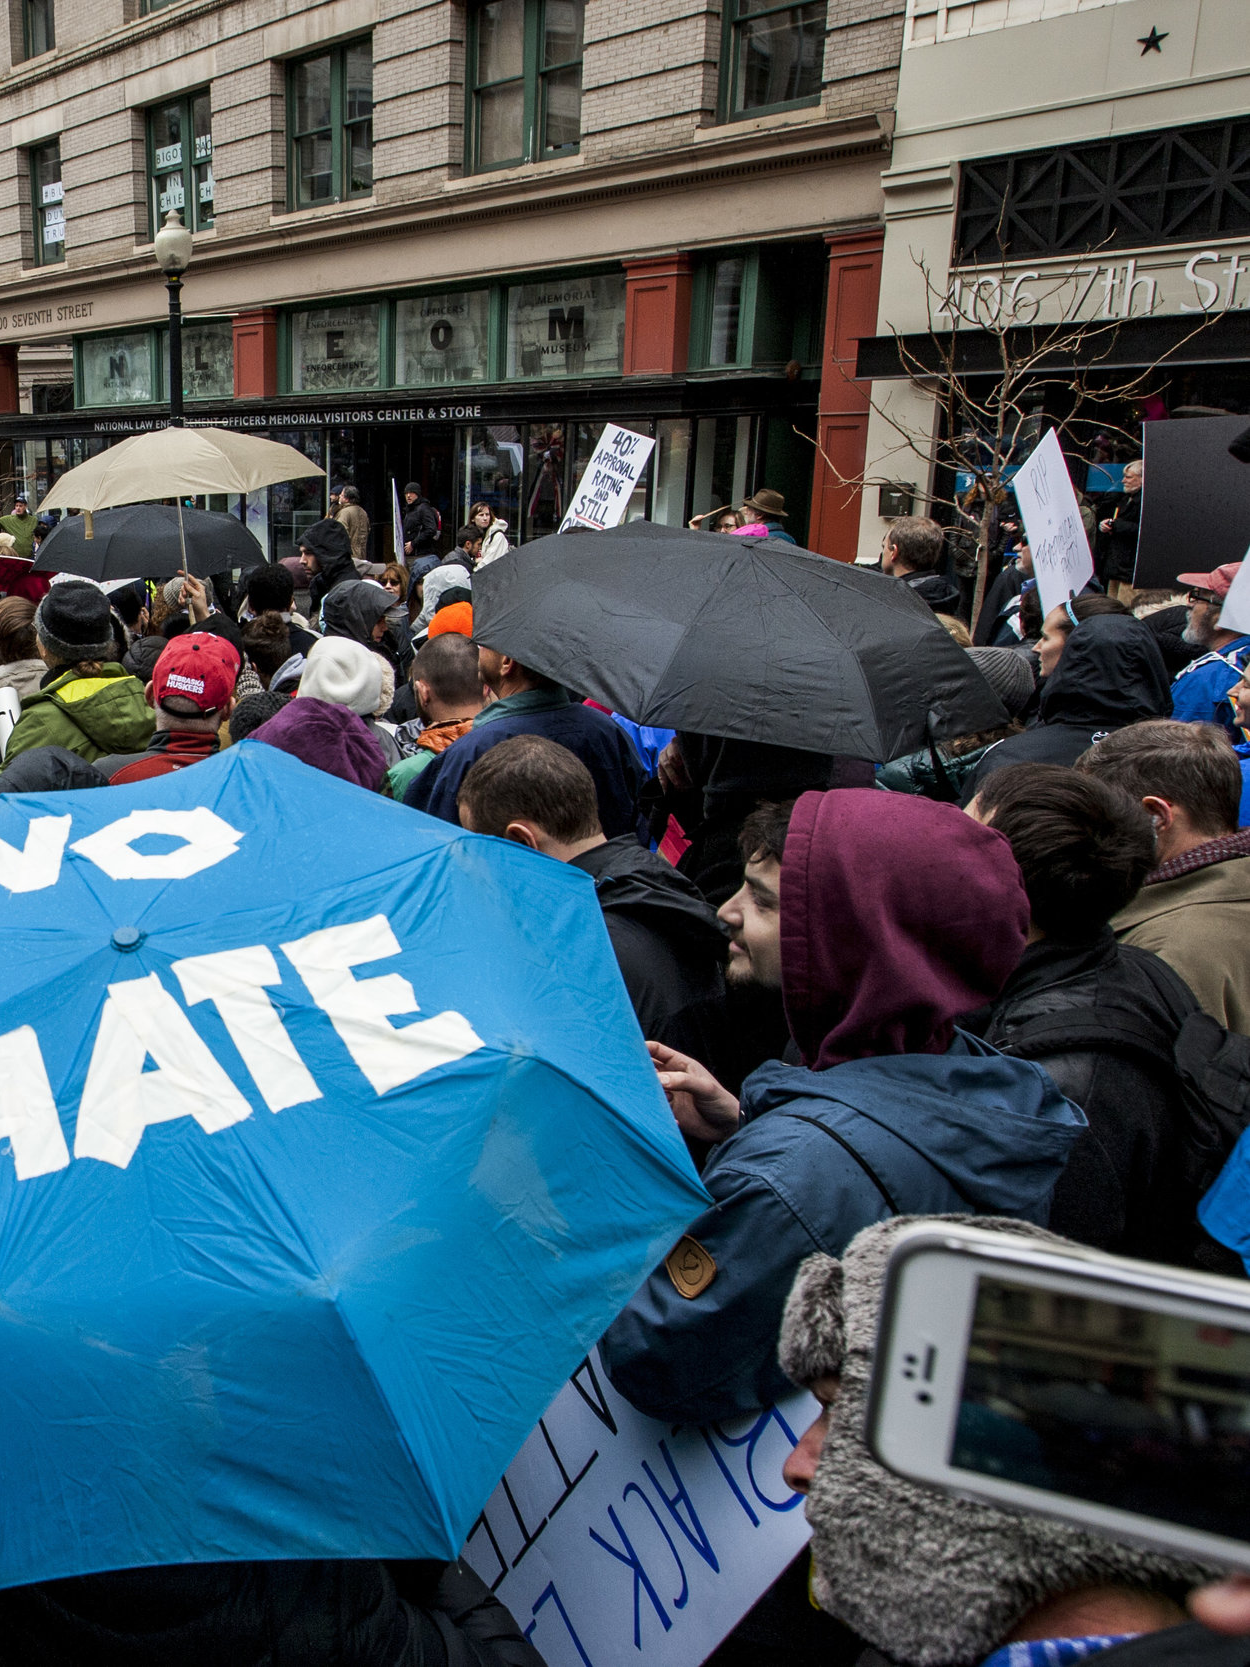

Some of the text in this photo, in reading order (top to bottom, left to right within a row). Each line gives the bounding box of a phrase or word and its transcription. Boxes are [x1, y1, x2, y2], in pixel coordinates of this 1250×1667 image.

[537, 290, 597, 305] MEMORIAL
[934, 271, 1040, 328] 406
[1066, 260, 1157, 322] 7th
[12, 309, 52, 328] SEVENTH
[57, 302, 93, 321] STREET
[420, 305, 465, 318] OFFICERS
[549, 305, 585, 340] M
[327, 331, 344, 359] E
[430, 319, 453, 350] O
[195, 346, 208, 370] L
[541, 342, 591, 354] MUSEUM
[306, 360, 364, 372] ENFORCEMENT
[94, 421, 133, 431] NATIONAL
[135, 420, 153, 430] LAW
[222, 416, 266, 427] OFFICERS
[270, 413, 322, 425] MEMORIAL
[324, 410, 373, 423] VISITORS
[377, 408, 423, 421] CENTER
[428, 408, 436, 419] &
[440, 405, 481, 418] STORE
[612, 430, 640, 457] 40%
[593, 449, 635, 481] APPROVAL
[591, 470, 624, 496] RATING
[594, 488, 609, 502] AND
[1030, 454, 1048, 510] RIP
[575, 495, 608, 526] STILL
[166, 680, 204, 694] HUSKERS
[168, 673, 205, 688] NEBRASKA
